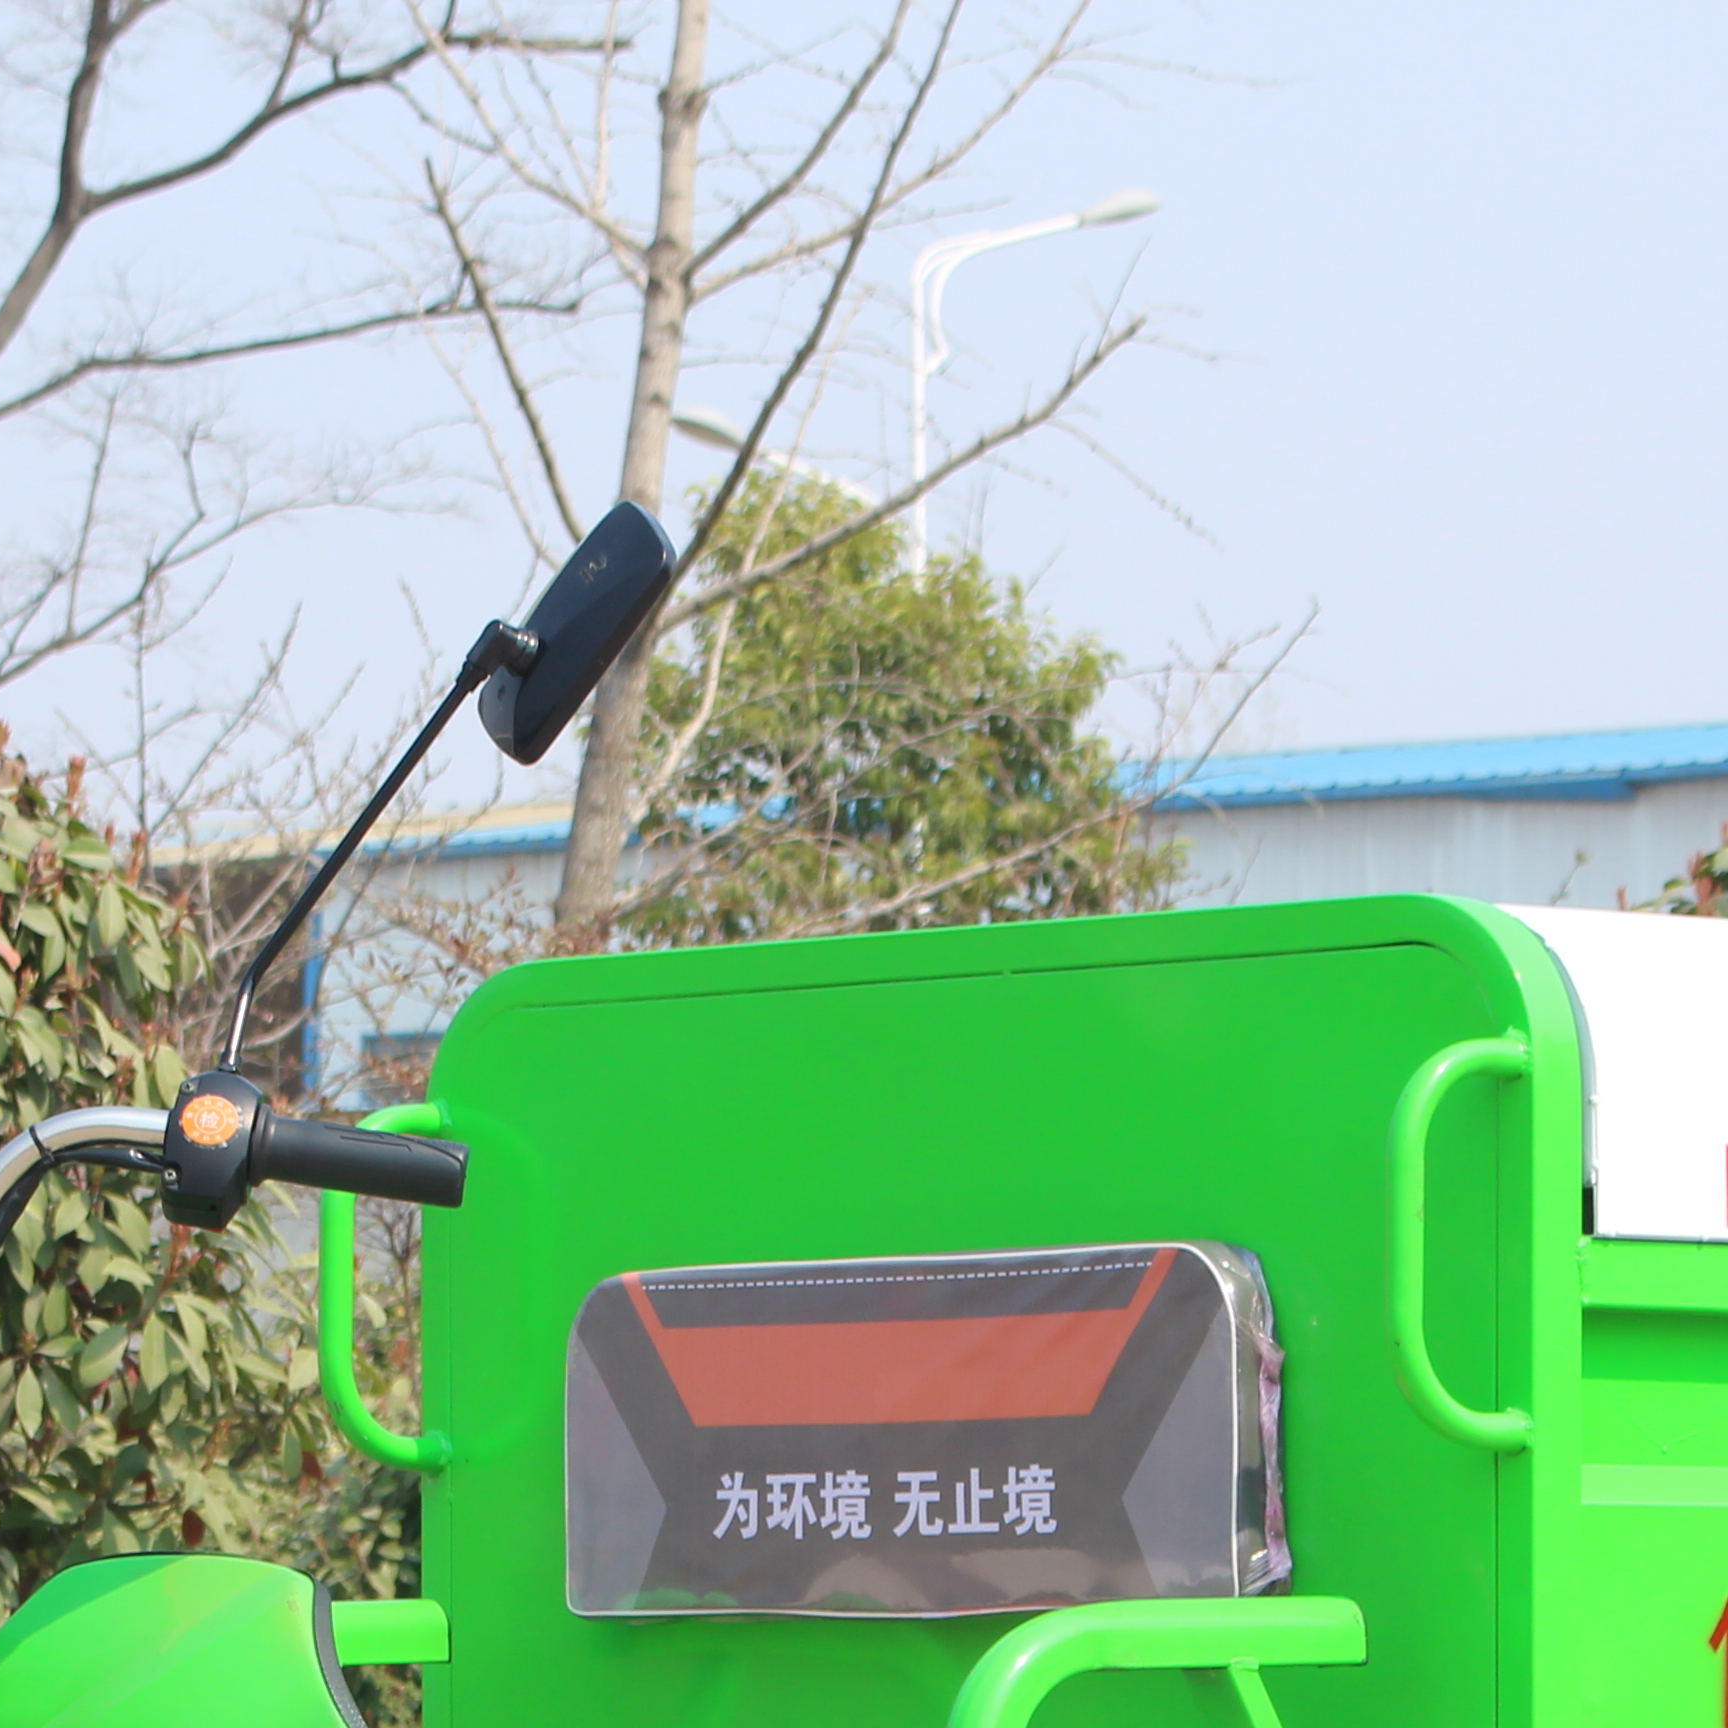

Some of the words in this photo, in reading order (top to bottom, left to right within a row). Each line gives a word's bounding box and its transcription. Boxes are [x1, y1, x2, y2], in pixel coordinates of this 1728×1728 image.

[712, 1469, 872, 1540] 为环境
[892, 1464, 1058, 1537] 无止境
